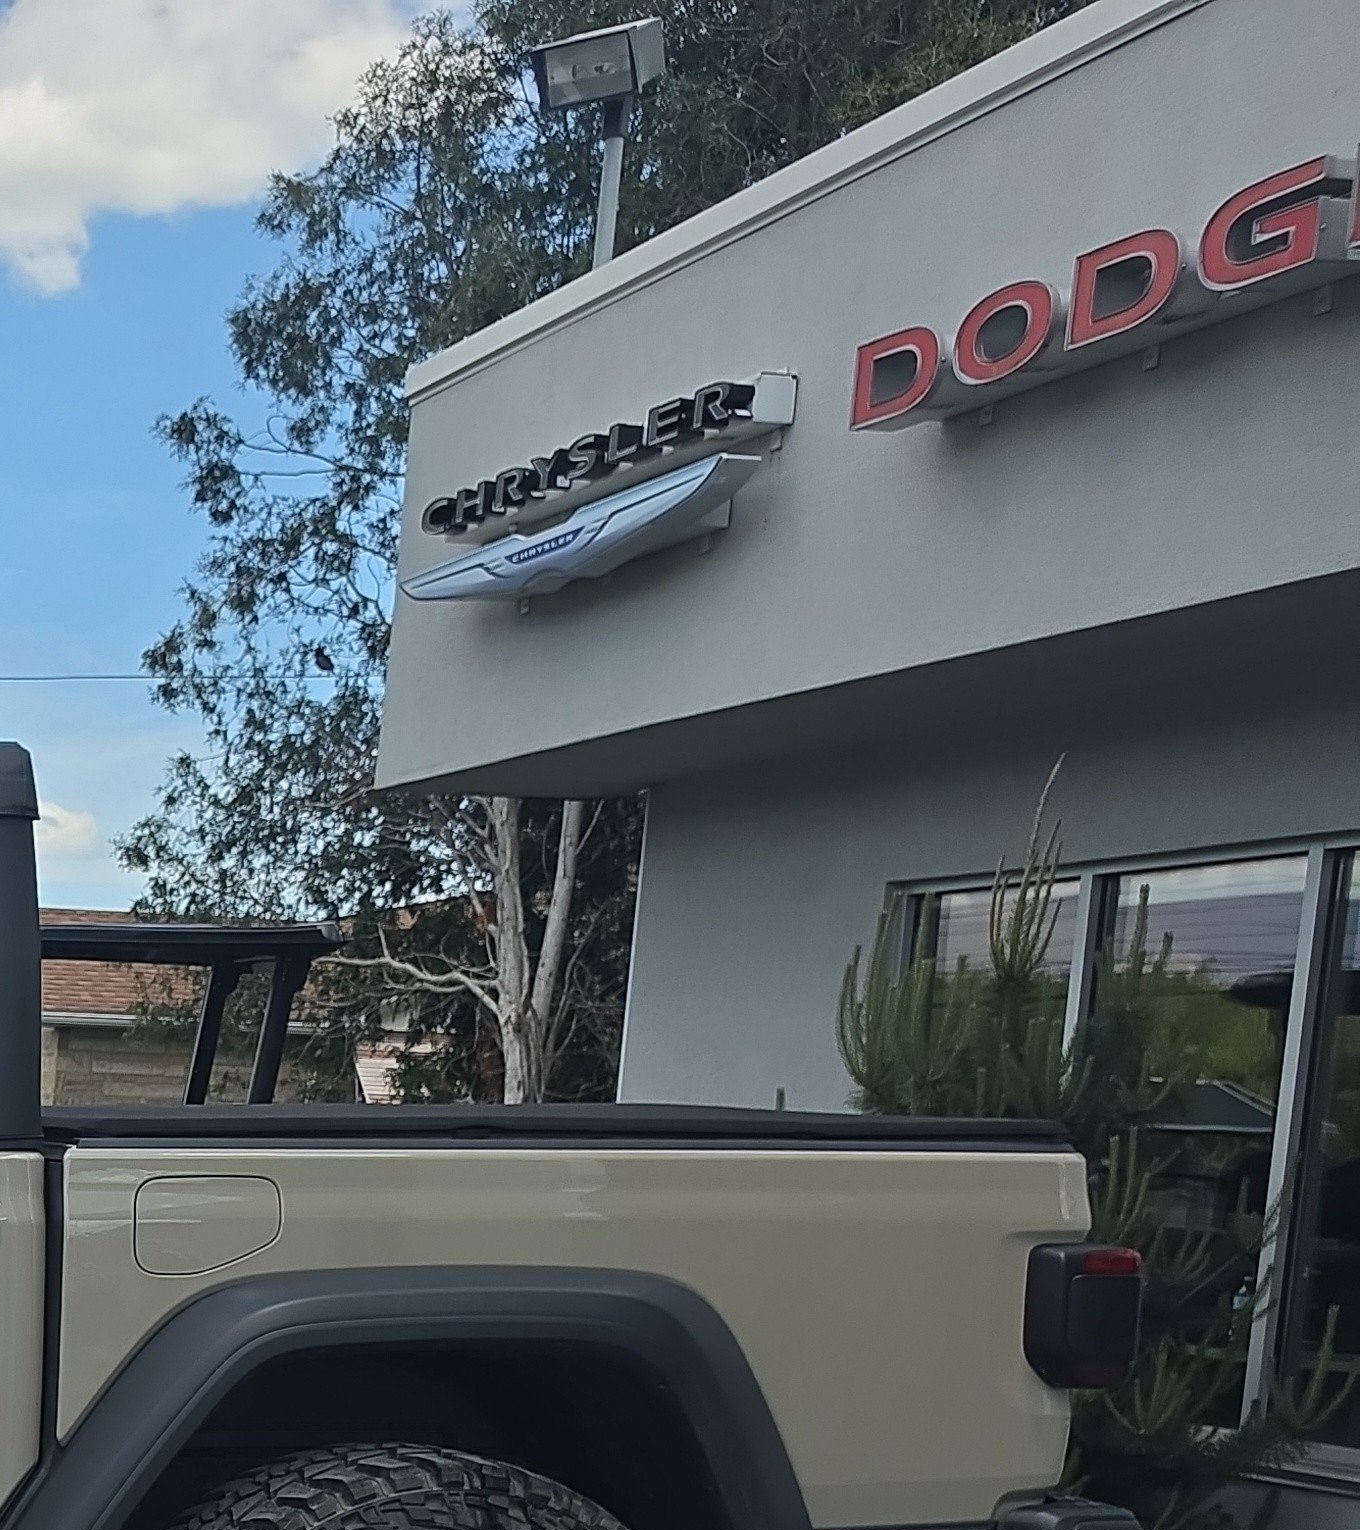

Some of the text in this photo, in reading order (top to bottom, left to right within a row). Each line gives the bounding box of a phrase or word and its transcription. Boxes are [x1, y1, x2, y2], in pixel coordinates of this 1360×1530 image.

[849, 142, 1360, 432] DODG
[421, 382, 734, 535] CHRYSLER
[511, 533, 575, 564] CHRYSLER
